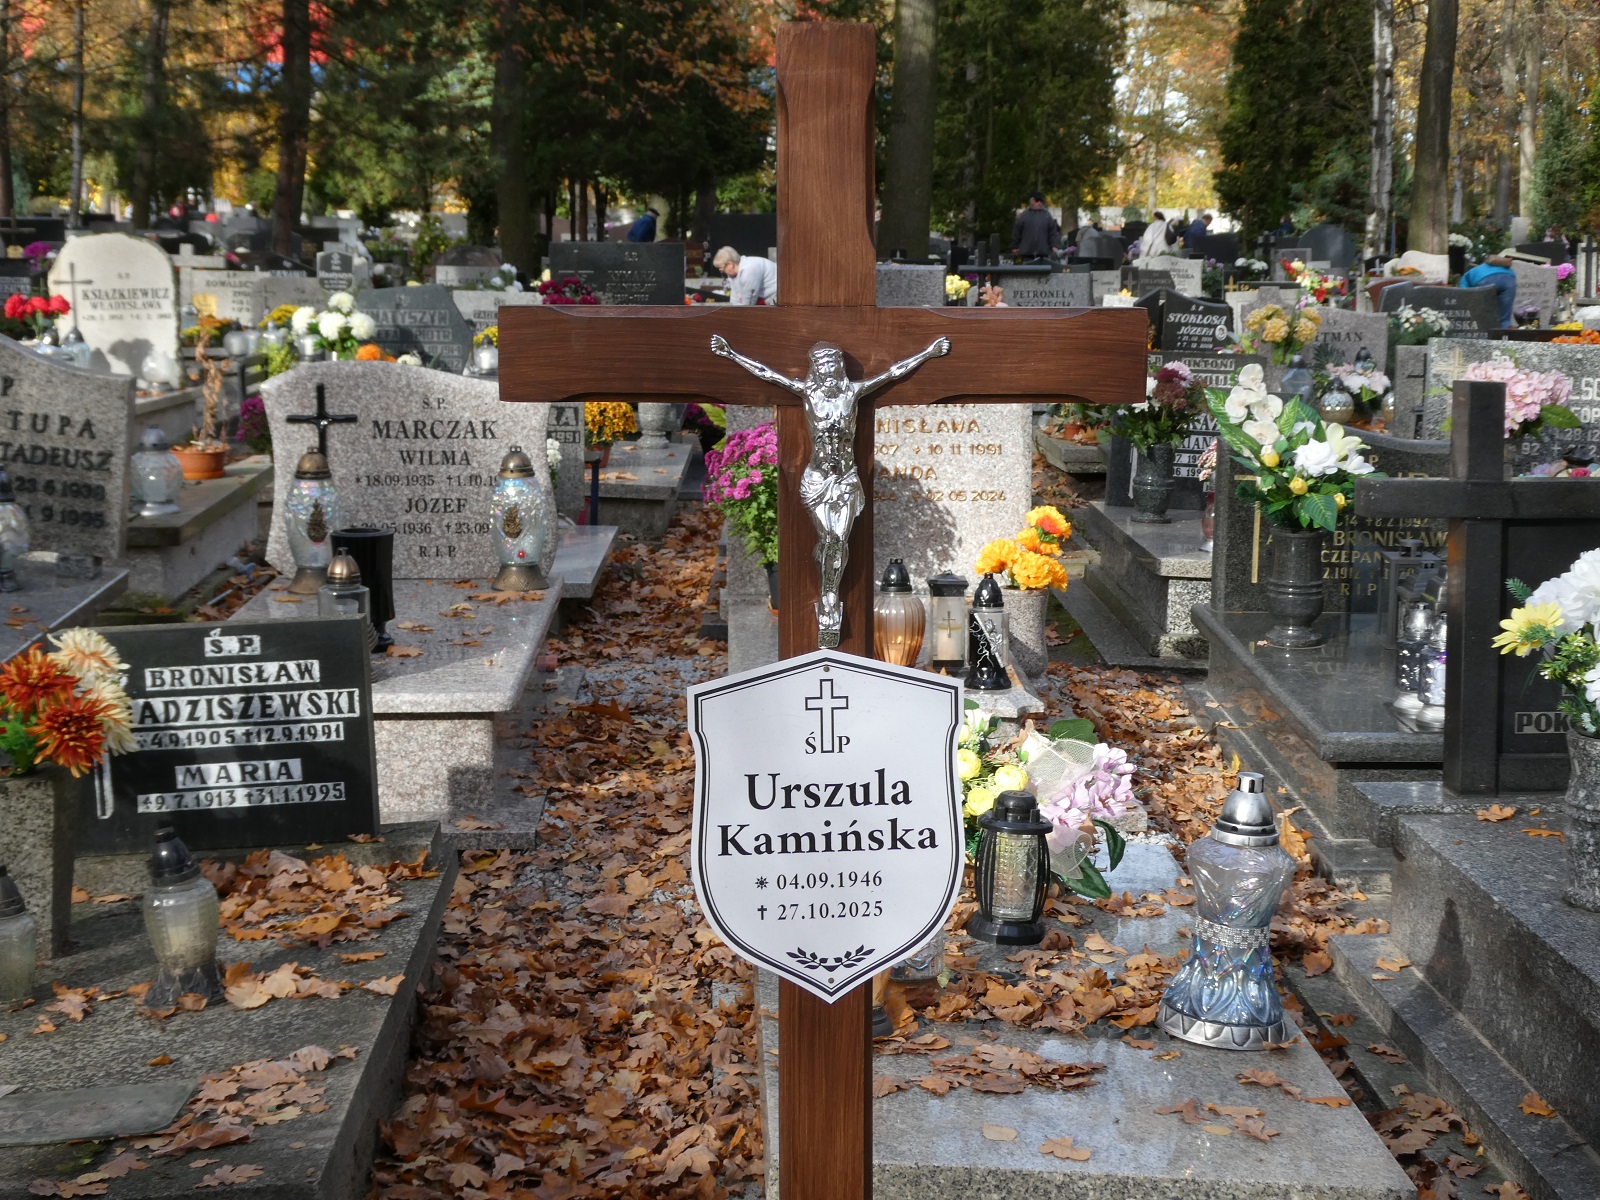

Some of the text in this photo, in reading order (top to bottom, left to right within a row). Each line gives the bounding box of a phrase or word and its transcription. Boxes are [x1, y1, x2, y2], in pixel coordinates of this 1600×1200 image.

[1013, 290, 1074, 298] PETRONELA
[1167, 313, 1227, 325] STOKŁOSA
[1177, 325, 1215, 335] JÓZEFA
[7, 410, 96, 439] TUPA
[372, 420, 498, 439] MARCZAK
[876, 419, 980, 433] NISŁAWA
[0, 441, 114, 472] TADEUSZ
[401, 450, 471, 465] WILMA
[928, 443, 943, 455] 10
[970, 443, 1003, 455] 1991
[366, 475, 435, 487] 18.09.1935
[874, 465, 938, 480] ANDA
[405, 494, 468, 514] JÓZEF
[925, 490, 944, 501] 02
[949, 490, 967, 501] 05
[149, 660, 315, 688] BRONISŁAW
[138, 690, 357, 725] ADZISZEWSKI
[182, 761, 295, 786] MARIA
[744, 768, 913, 810] Urszula
[717, 818, 939, 856] Kamińska
[776, 870, 882, 890] 04.09.1946
[777, 900, 883, 920] 27.10.2025
